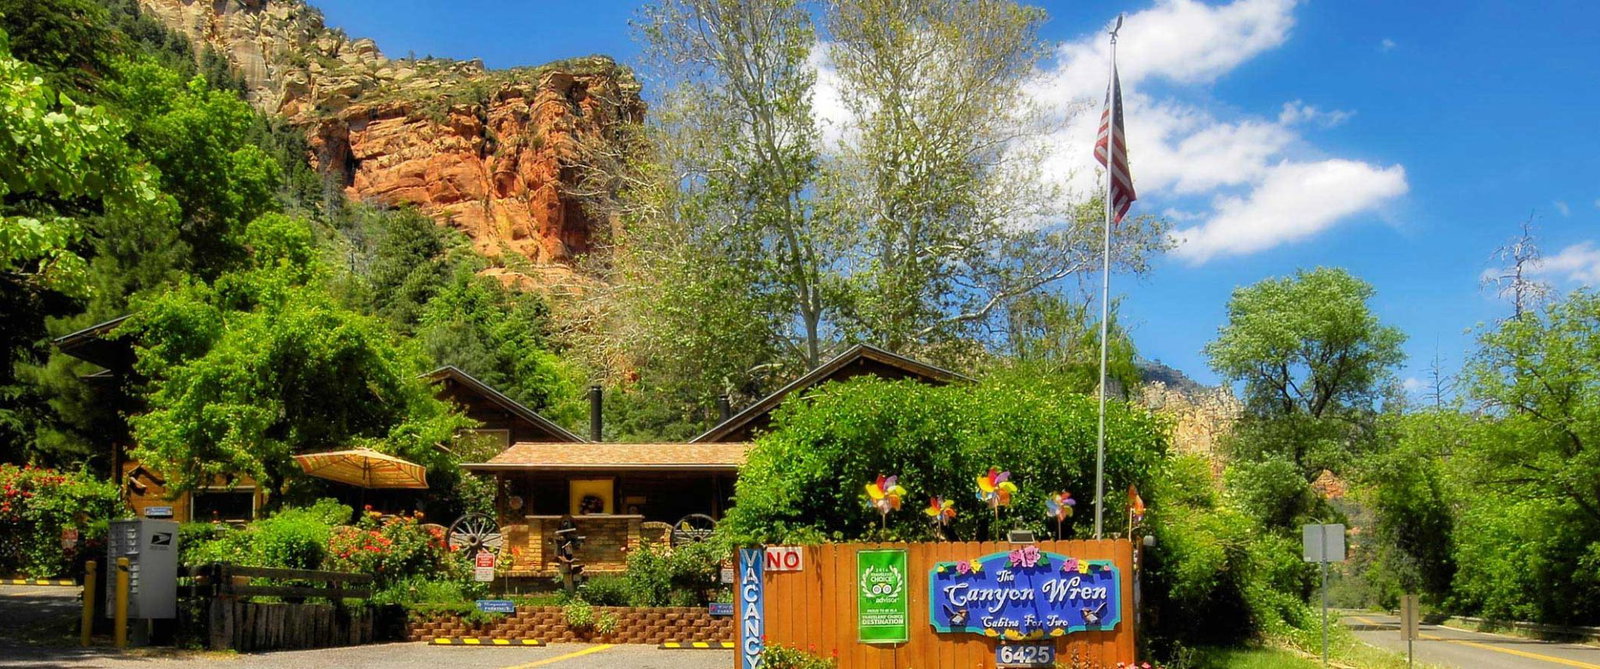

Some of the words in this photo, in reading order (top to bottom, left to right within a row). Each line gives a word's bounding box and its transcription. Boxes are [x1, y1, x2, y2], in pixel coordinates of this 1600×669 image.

[767, 551, 800, 568] NO
[996, 570, 1015, 582] The
[943, 583, 1034, 613] Canyon
[1042, 576, 1107, 602] Wren
[743, 550, 760, 669] VACANCY
[981, 616, 1019, 627] Cabins
[1024, 614, 1043, 626] For
[1046, 614, 1068, 626] Two
[1001, 646, 1050, 663] 6425
